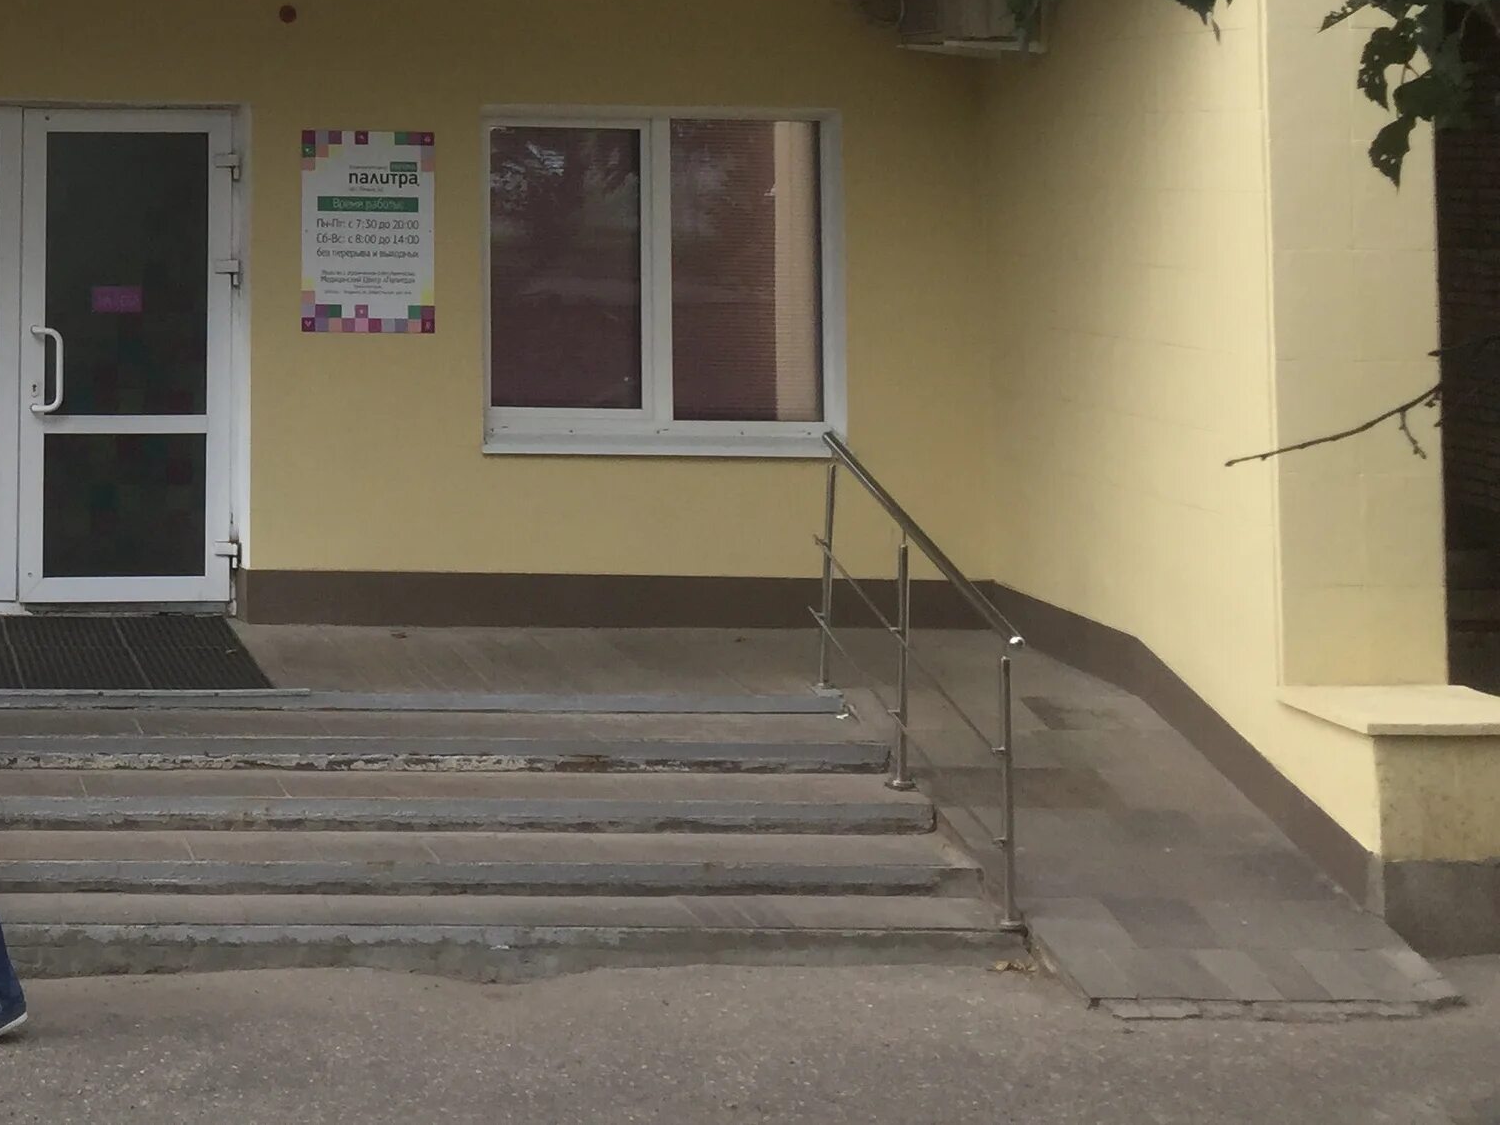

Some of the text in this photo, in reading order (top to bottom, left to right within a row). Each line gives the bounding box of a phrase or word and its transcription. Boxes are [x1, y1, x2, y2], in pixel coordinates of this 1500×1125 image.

[348, 172, 418, 188] палитра
[378, 220, 391, 230] до
[392, 219, 420, 230] 20:00
[355, 234, 377, 244] 8:00
[378, 236, 391, 245] до
[393, 234, 420, 245] 14:00
